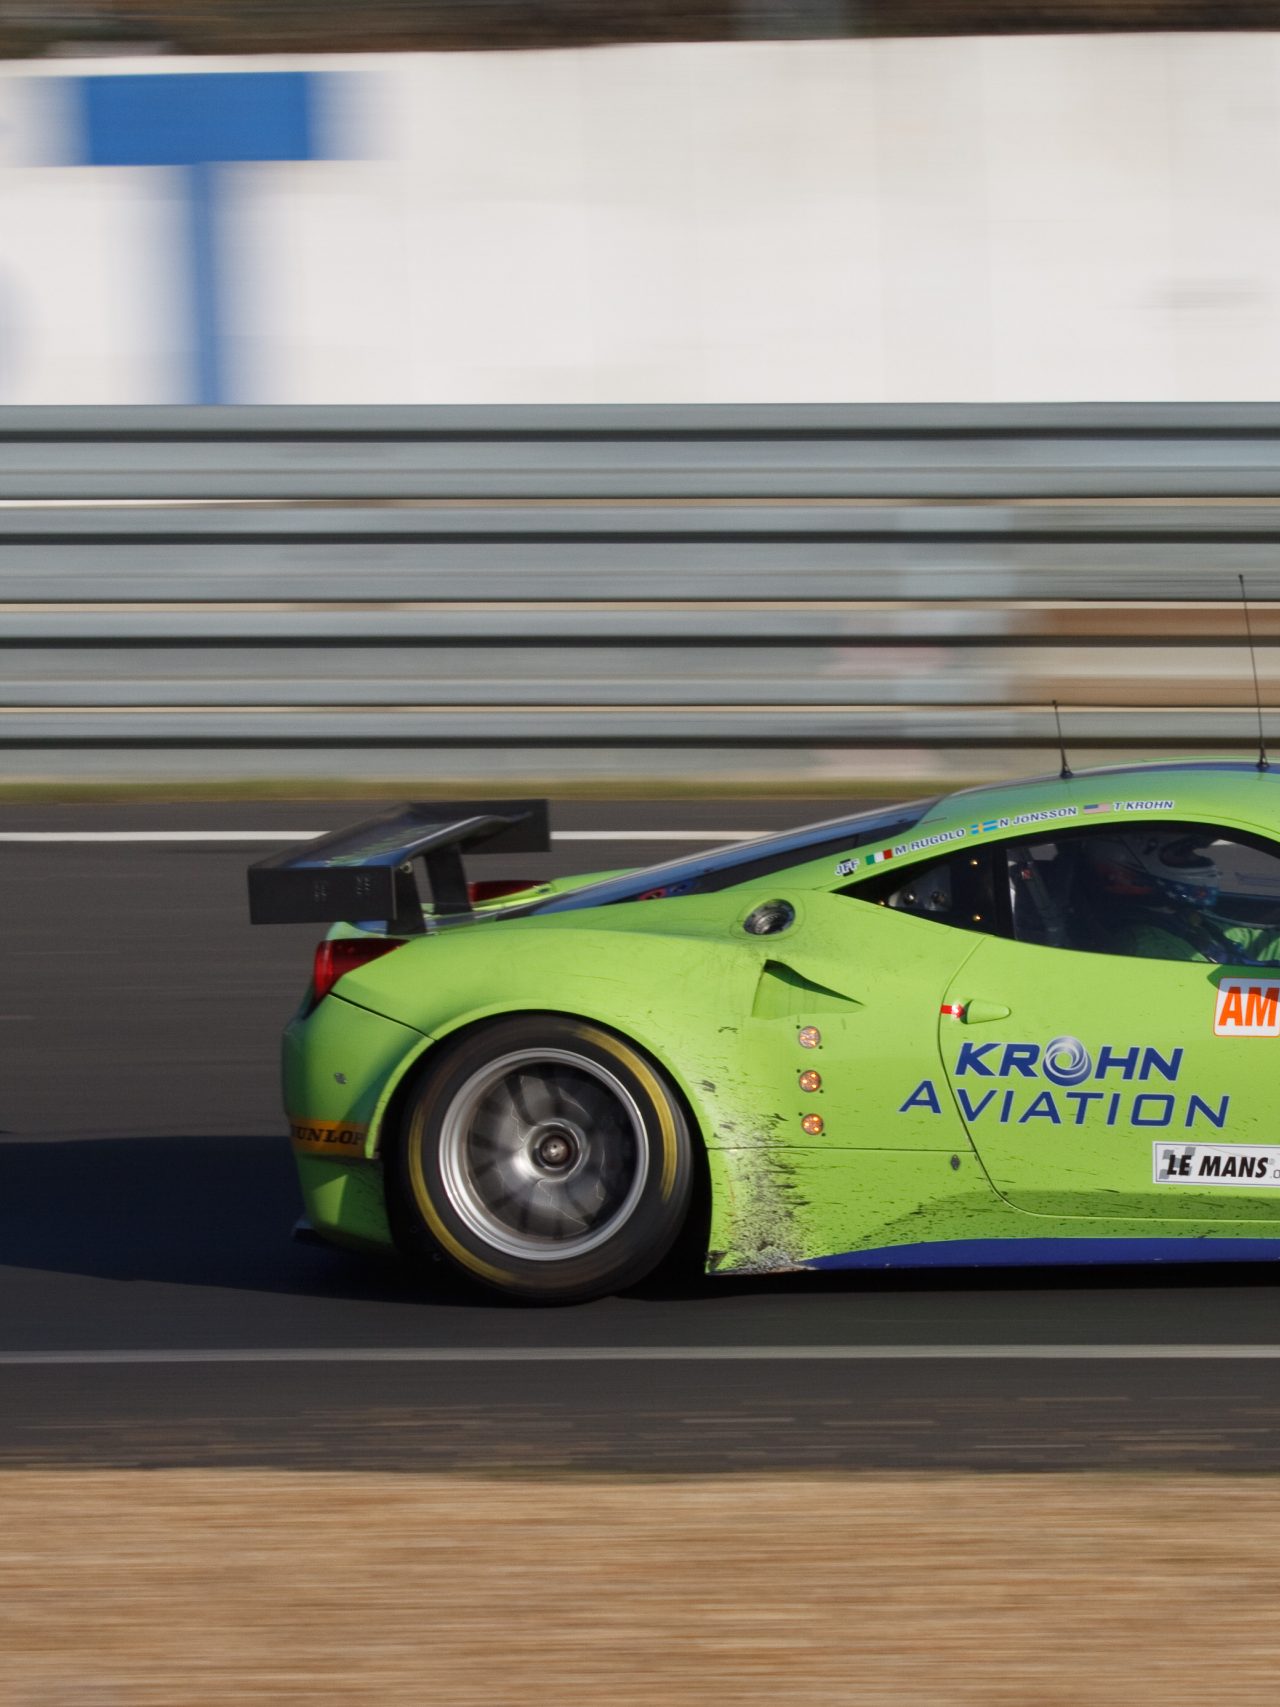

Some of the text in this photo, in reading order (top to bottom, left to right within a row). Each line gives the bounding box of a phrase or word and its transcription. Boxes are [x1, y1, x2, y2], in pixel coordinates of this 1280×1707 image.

[1114, 801, 1174, 811] T KROHN
[1000, 818, 1009, 827] N
[895, 828, 965, 856] M RUGOLO
[1218, 986, 1280, 1027] AM
[954, 1035, 1184, 1087] KROHN
[898, 1079, 1231, 1129] AVIATION
[1167, 1154, 1193, 1176] LE
[1198, 1155, 1268, 1178] MANS
